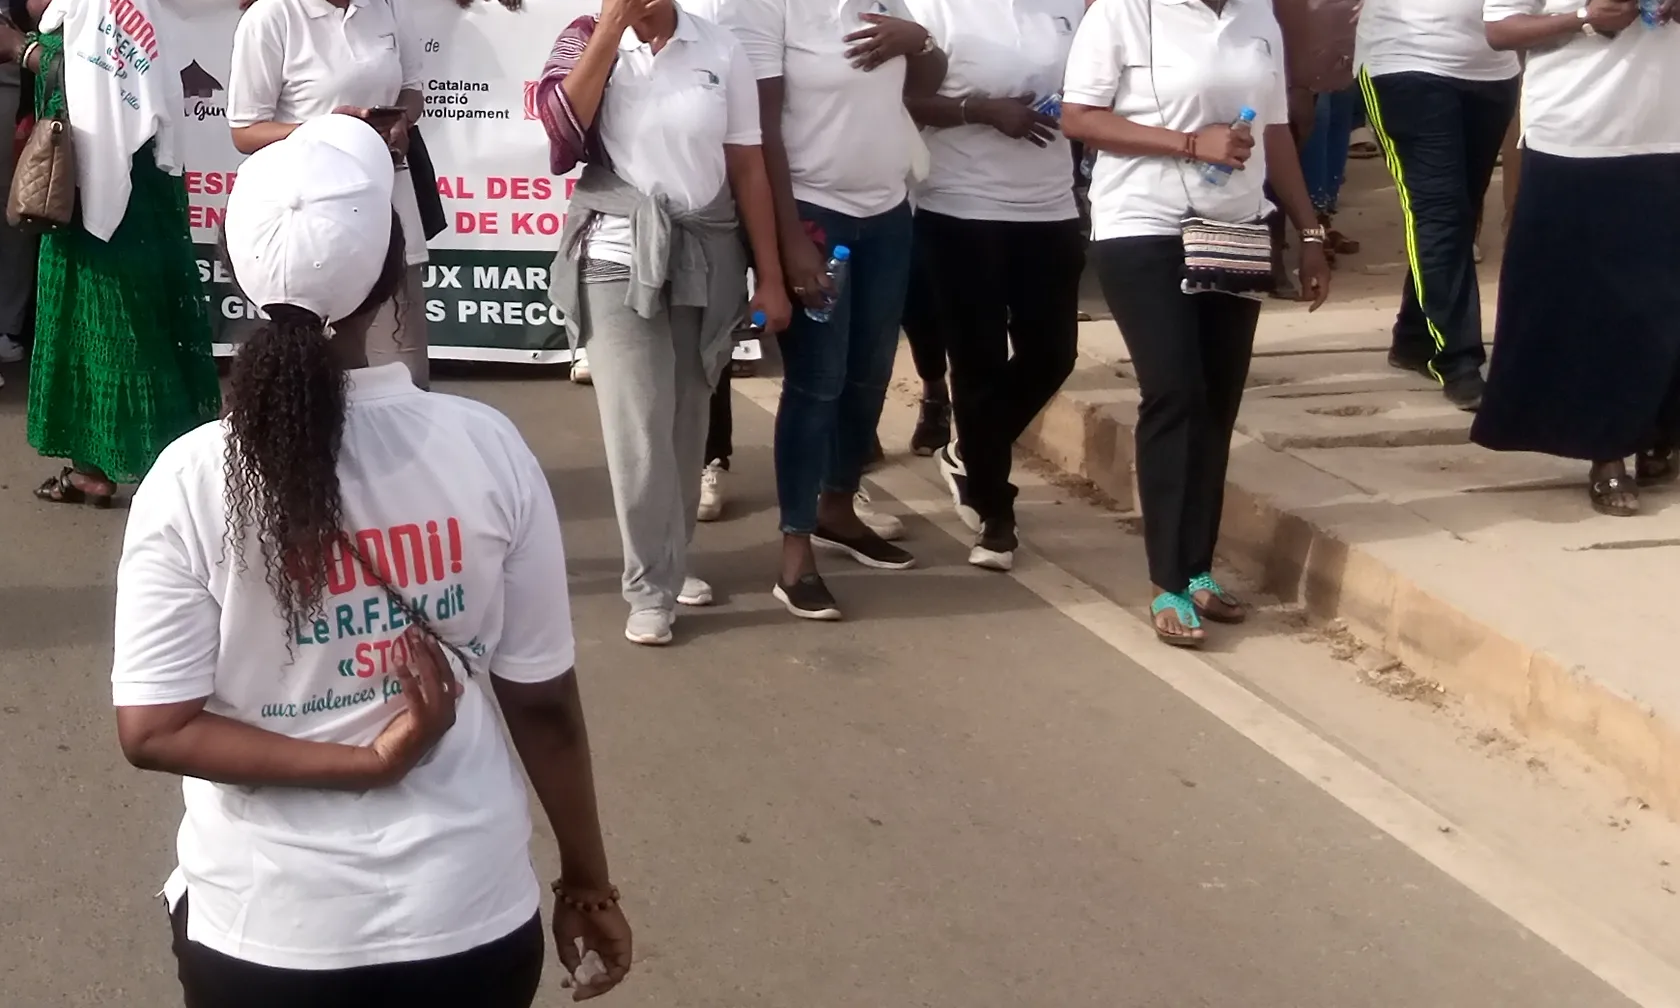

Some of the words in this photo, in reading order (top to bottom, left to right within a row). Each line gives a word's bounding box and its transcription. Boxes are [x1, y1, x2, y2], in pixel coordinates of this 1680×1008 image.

[428, 79, 489, 92] Catalana
[486, 178, 551, 200] DES
[455, 212, 498, 234] DE
[295, 612, 329, 645] Le
[436, 584, 464, 620] dit
[261, 701, 296, 718] aux
[302, 689, 375, 714] violences
